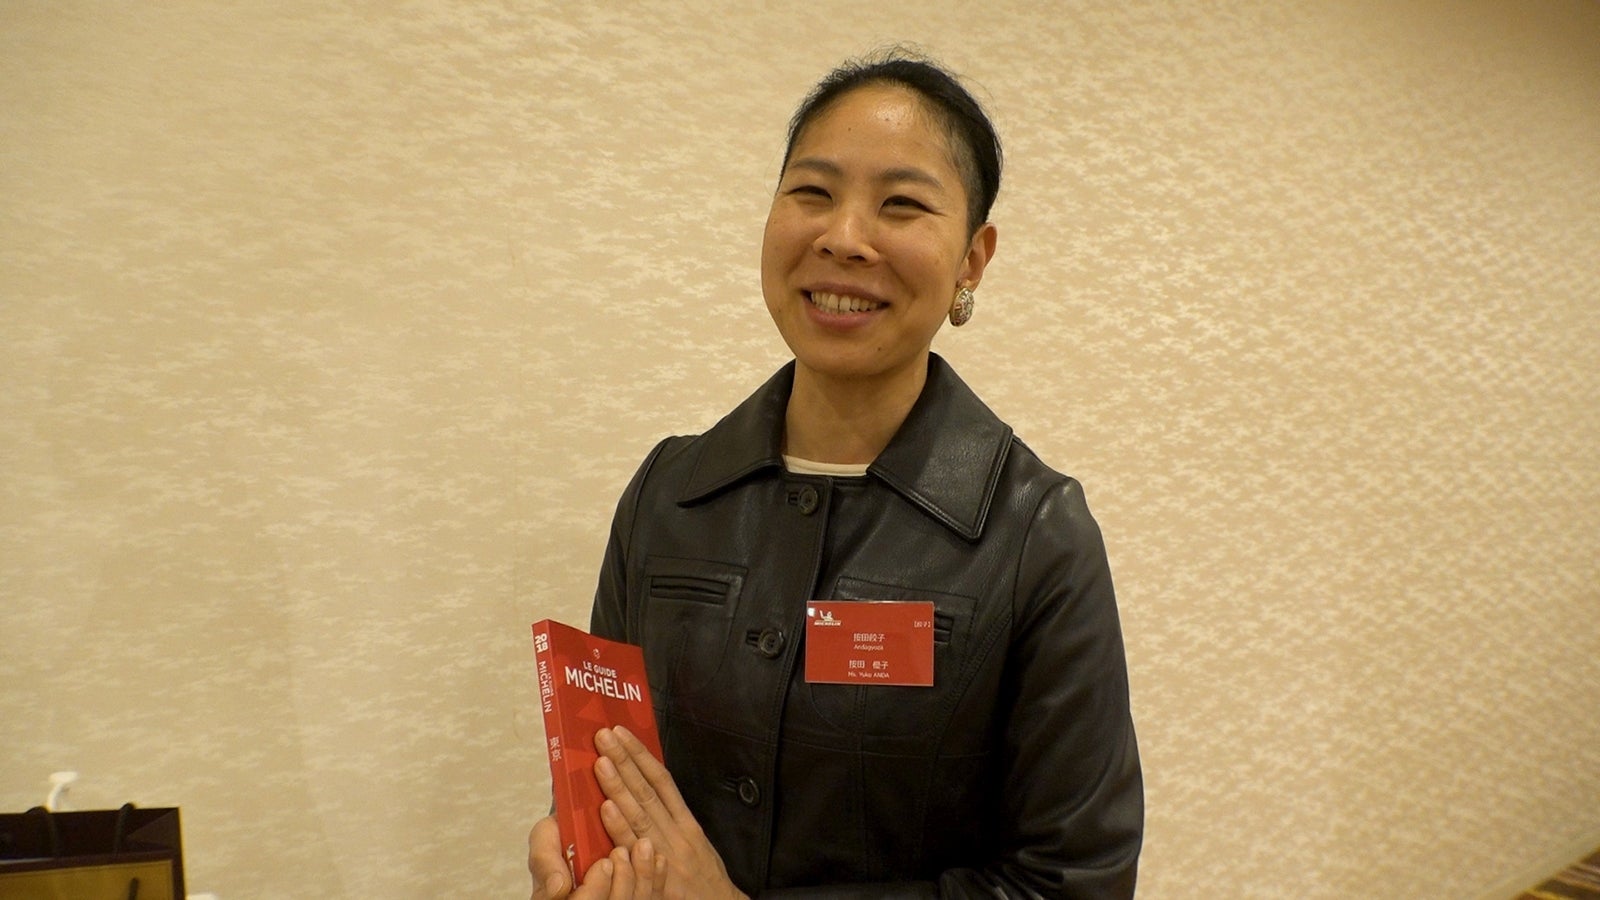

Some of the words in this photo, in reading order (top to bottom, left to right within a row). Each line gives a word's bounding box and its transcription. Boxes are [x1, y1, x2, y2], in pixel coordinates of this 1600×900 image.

[535, 633, 548, 644] 20
[536, 642, 549, 653] 18
[583, 660, 593, 671] LE
[593, 664, 617, 678] GUIDE
[538, 660, 552, 713] MICHELIN
[565, 666, 642, 702] MICHELIN
